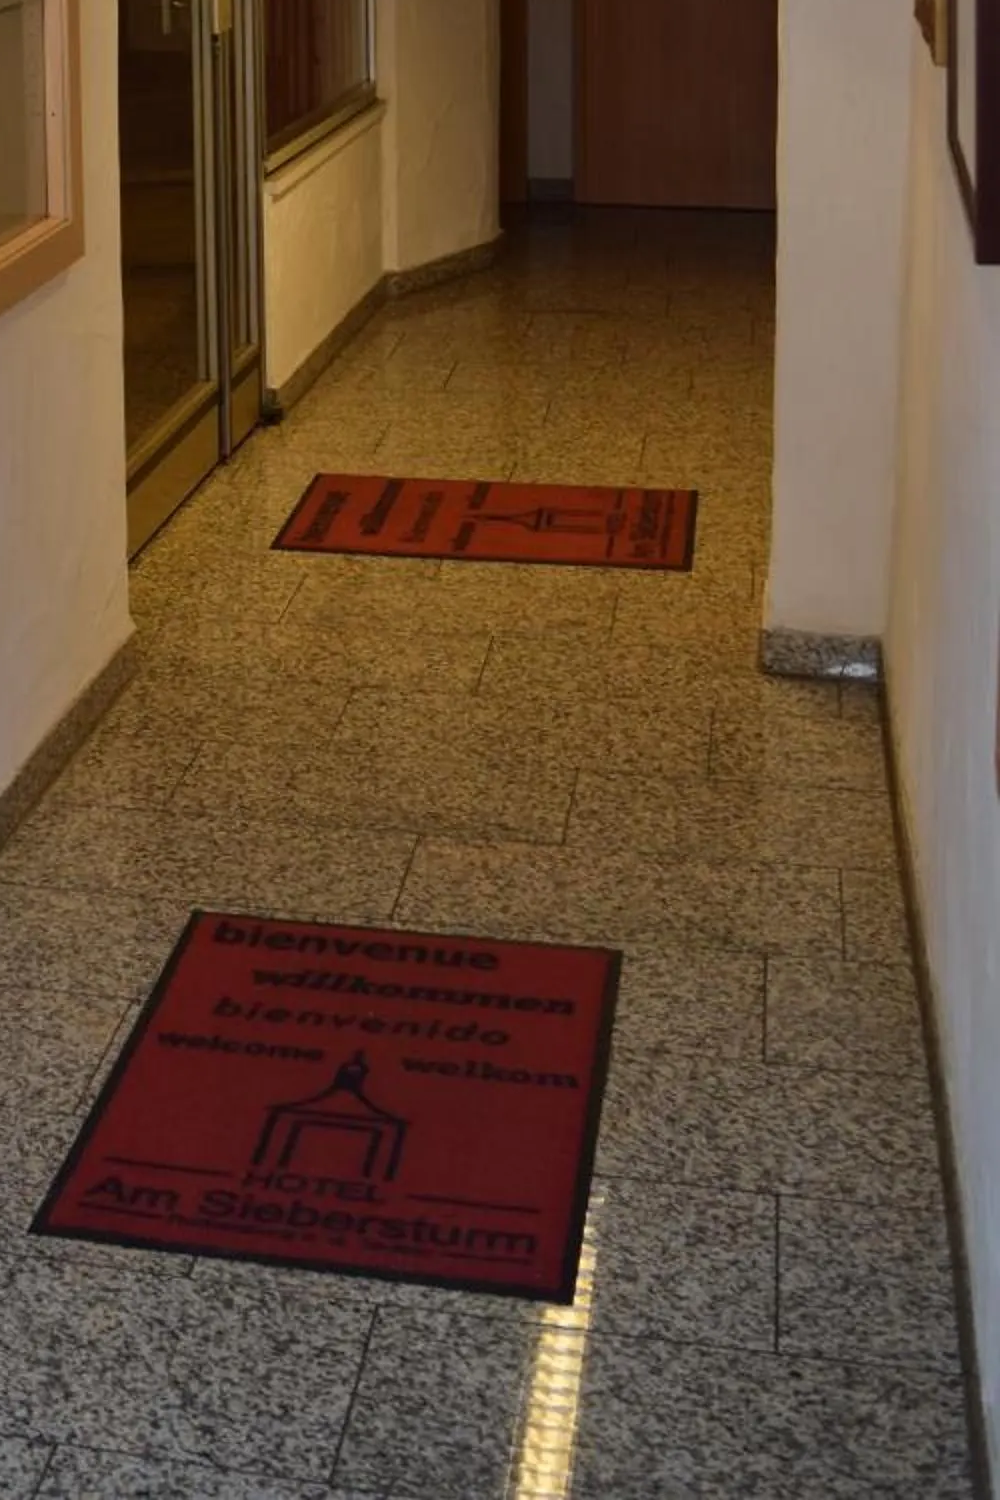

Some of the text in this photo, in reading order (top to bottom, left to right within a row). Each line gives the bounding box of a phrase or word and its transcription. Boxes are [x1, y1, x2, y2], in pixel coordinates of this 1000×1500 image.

[212, 921, 498, 971] bienvenue
[250, 967, 576, 1016] willkommen
[212, 997, 511, 1047] bienvenido
[156, 1030, 580, 1090] welcome welkom
[242, 1169, 381, 1202] HOTEL
[85, 1174, 179, 1211] Am
[199, 1188, 540, 1256] Siebersturm
